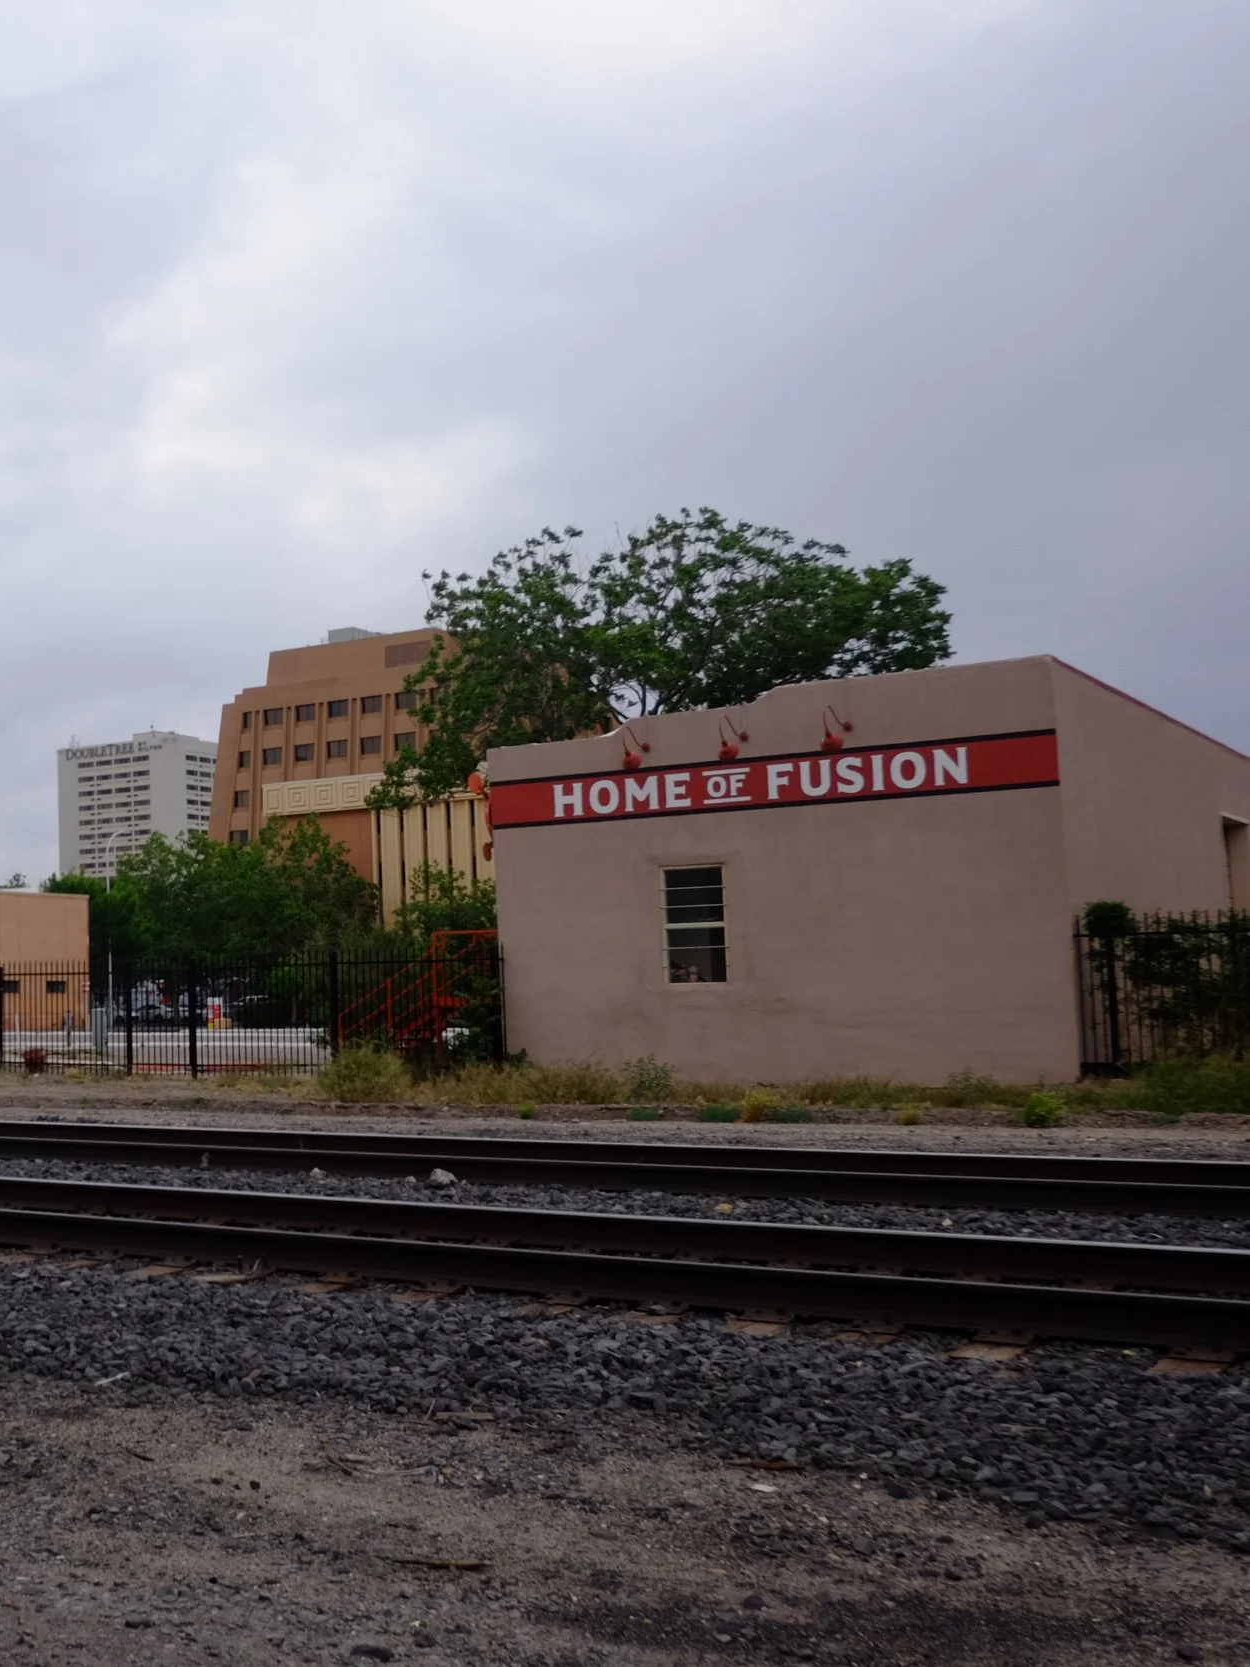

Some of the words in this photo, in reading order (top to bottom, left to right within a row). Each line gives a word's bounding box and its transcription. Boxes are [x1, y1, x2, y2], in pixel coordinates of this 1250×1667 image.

[553, 772, 692, 817] HOME
[707, 774, 747, 798] OF
[766, 746, 969, 799] FUSION
